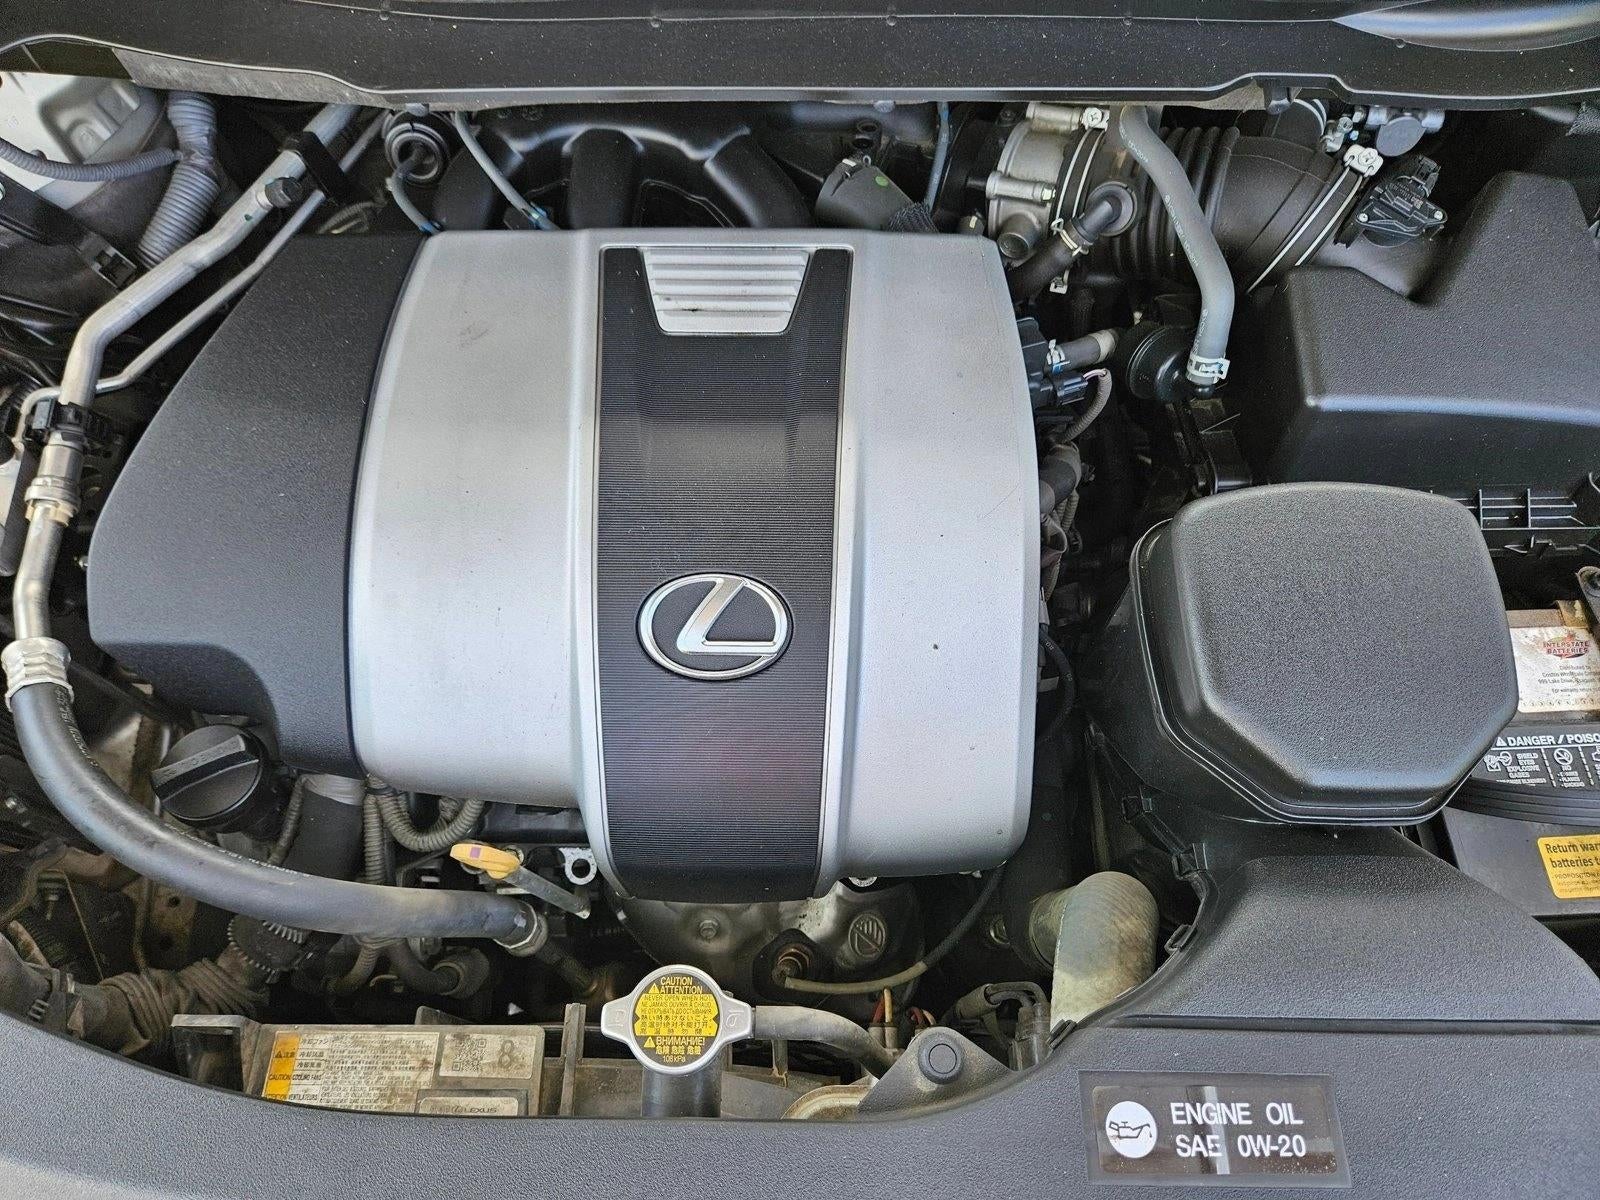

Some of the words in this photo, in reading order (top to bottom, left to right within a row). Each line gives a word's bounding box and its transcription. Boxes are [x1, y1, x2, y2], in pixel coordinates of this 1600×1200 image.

[1507, 736, 1556, 746] DANGER
[1545, 843, 1579, 854] Return
[1550, 856, 1594, 868] batteries
[660, 976, 693, 986] CAUTION
[660, 985, 703, 995] ATTENTION
[656, 1036, 706, 1046] ВНИМАНИЕ!
[269, 1073, 291, 1081] CAUTION
[464, 1106, 498, 1114] LEXUS
[1170, 1102, 1253, 1125] ENGINE
[1265, 1102, 1304, 1125] OIL
[1176, 1134, 1222, 1158] SAE
[1237, 1134, 1306, 1158] 0W-20
